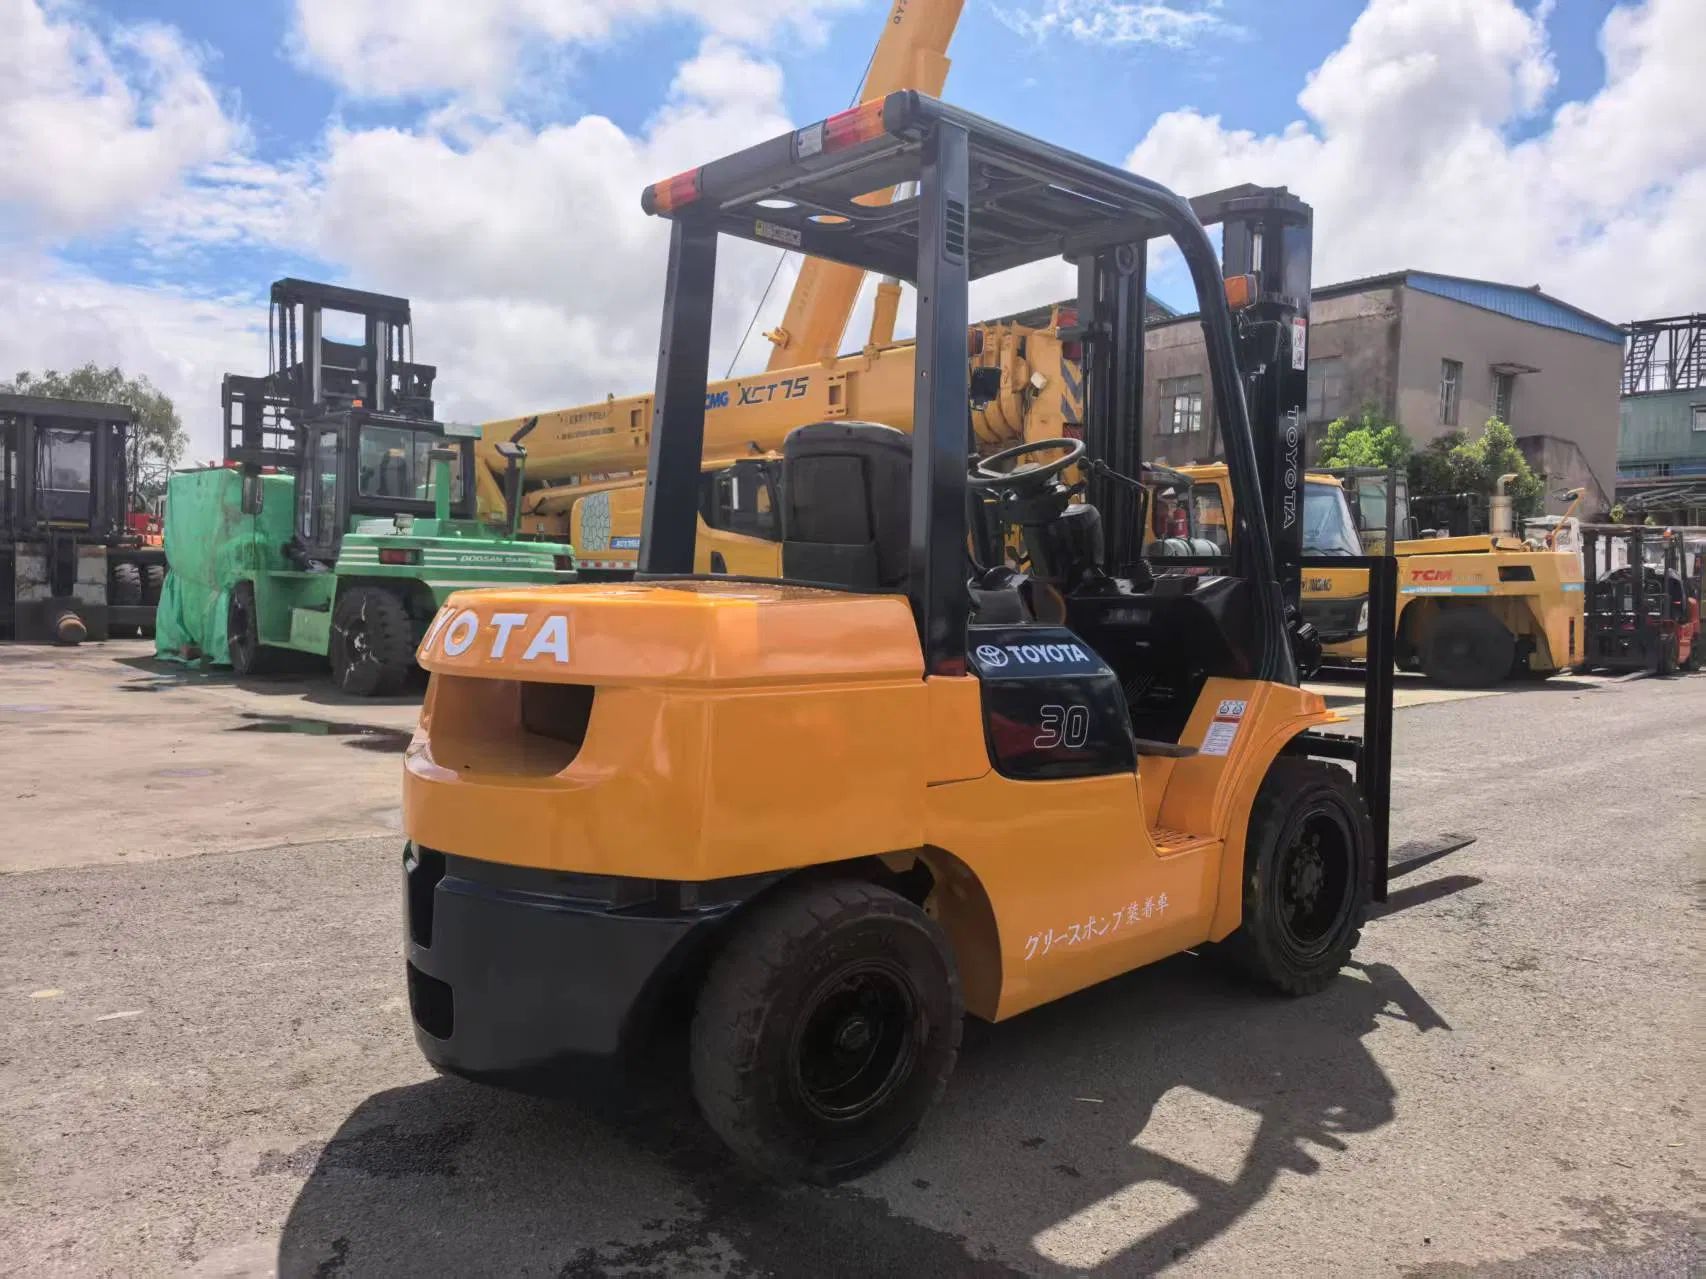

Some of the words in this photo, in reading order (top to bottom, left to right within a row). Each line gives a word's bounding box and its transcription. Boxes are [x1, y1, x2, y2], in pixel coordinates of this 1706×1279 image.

[1284, 405, 1299, 528] TOYOTA
[1411, 570, 1452, 581] TCM
[1005, 644, 1090, 663] TOYOTA
[1034, 705, 1090, 748] 30
